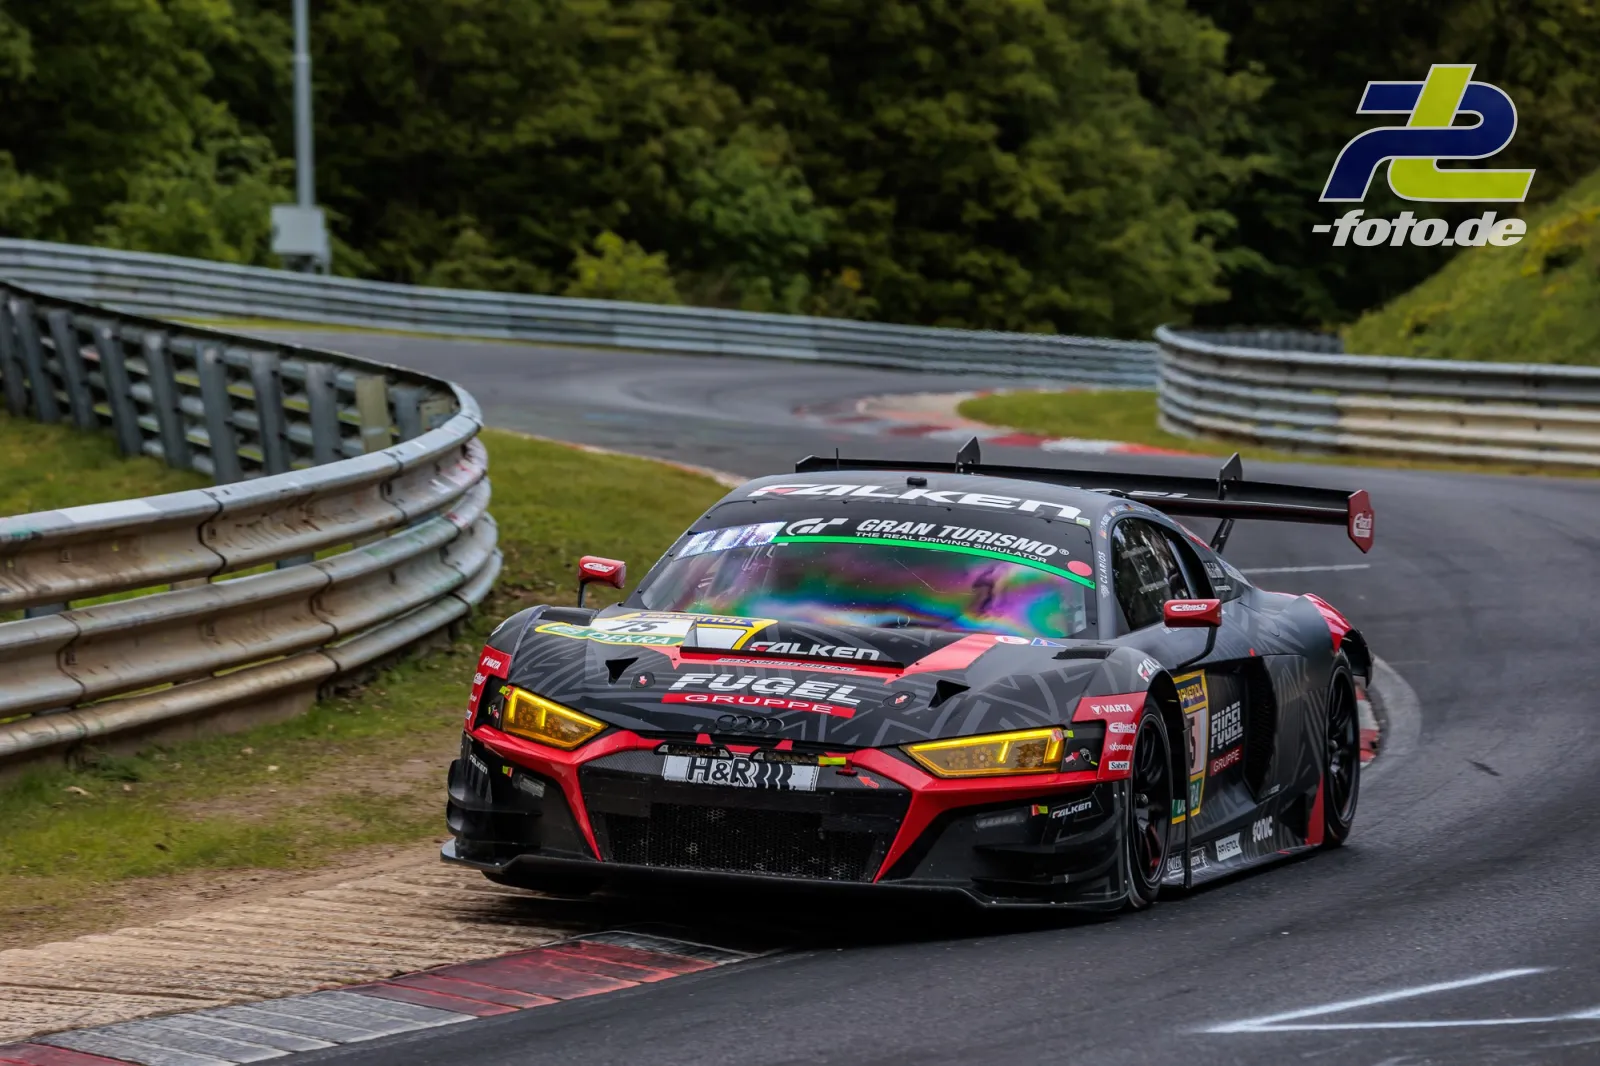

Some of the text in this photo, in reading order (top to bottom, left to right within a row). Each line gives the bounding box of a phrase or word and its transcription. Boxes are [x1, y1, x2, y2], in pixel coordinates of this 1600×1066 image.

[748, 484, 1082, 520] FALKEN
[856, 519, 937, 536] GRAN
[882, 533, 915, 541] REAL
[919, 536, 971, 548] DRIVING
[973, 543, 1048, 564] SIMULATOR
[1098, 551, 1108, 584] CLARIOS
[606, 620, 669, 633] 75
[587, 632, 671, 645] DEKRA
[750, 641, 880, 661] FALKEN
[668, 672, 862, 706] FUGEL
[684, 694, 832, 714] GRUPPE
[1102, 704, 1133, 713] VARTA
[469, 753, 488, 775] FALKEN
[687, 756, 751, 785] H&R
[1213, 749, 1240, 772] GRUPPE
[1052, 801, 1092, 819] FALKEN
